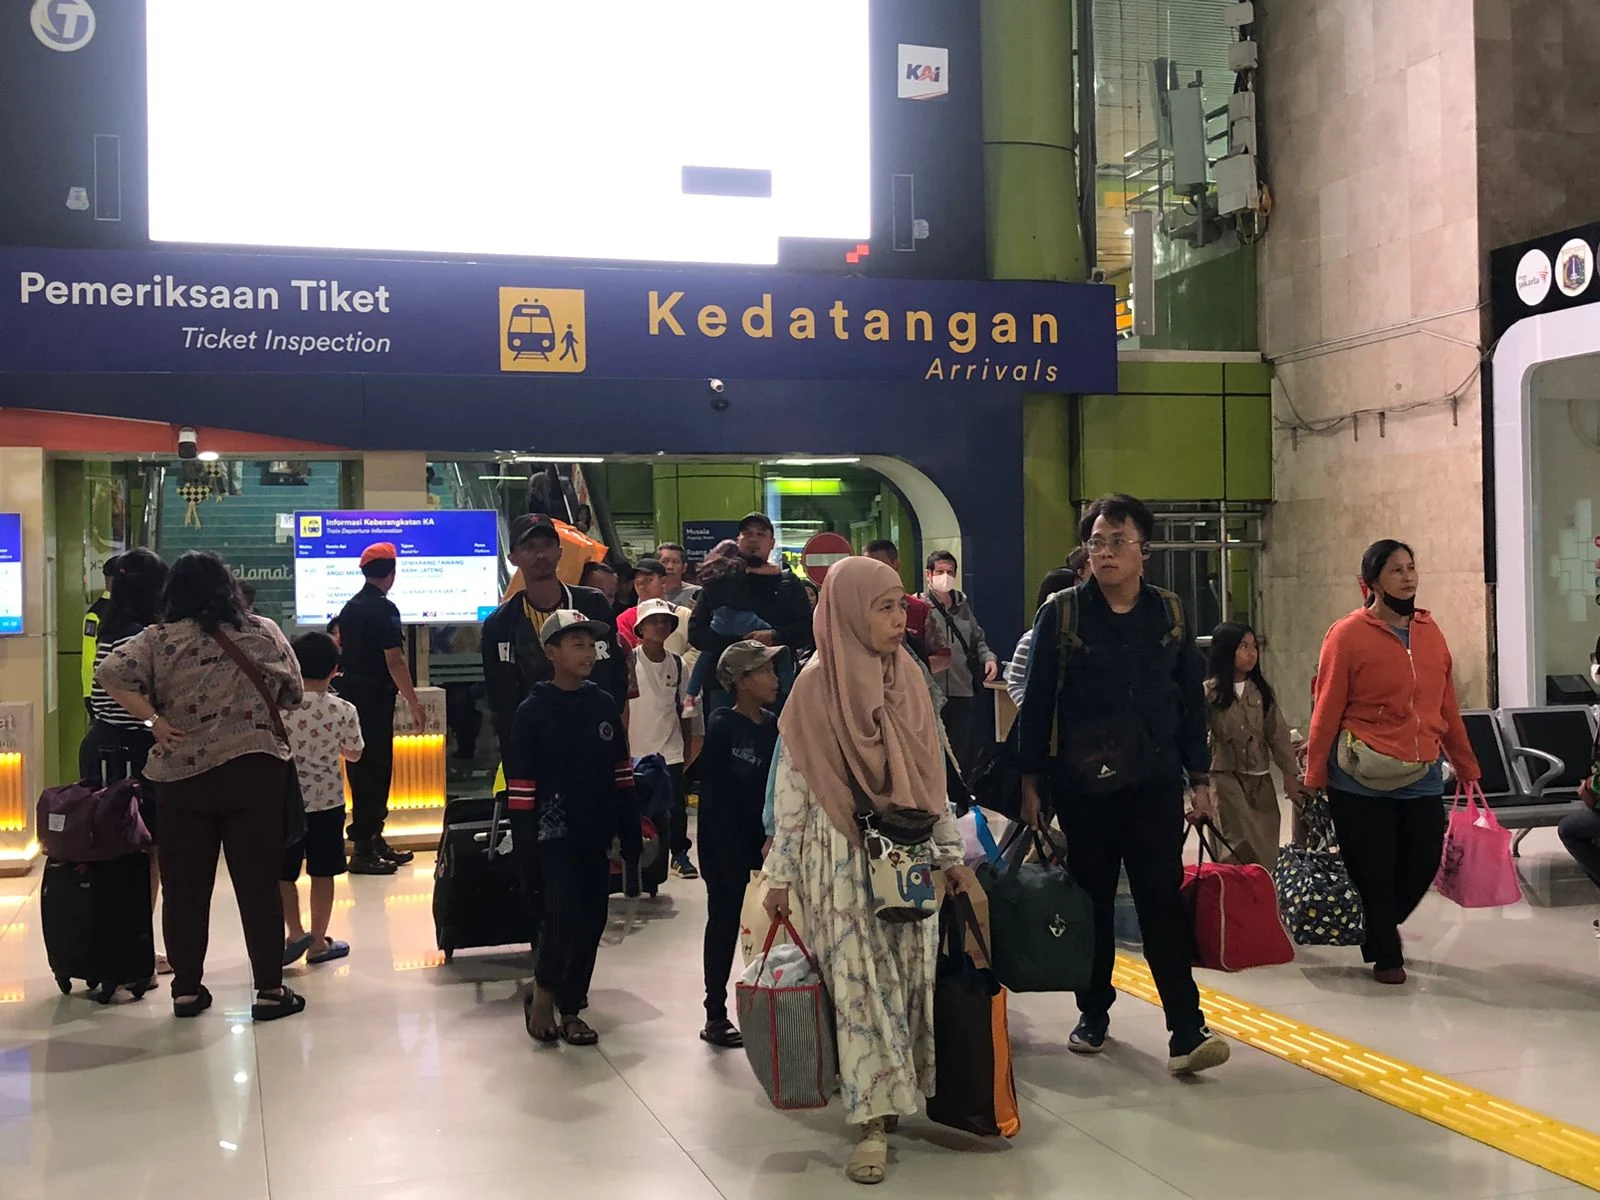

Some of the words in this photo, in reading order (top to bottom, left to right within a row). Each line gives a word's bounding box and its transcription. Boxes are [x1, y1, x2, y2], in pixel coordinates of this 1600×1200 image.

[20, 271, 279, 310] Pemeriksaan
[291, 279, 391, 314] Tiket
[648, 290, 1060, 354] Kedatangan
[182, 327, 257, 351] Ticket
[265, 329, 391, 356] Inspection
[926, 357, 1059, 383] Arrivals
[326, 518, 362, 526] Informasi
[364, 518, 421, 527] Keberangkatan
[423, 518, 436, 526] KA
[231, 564, 293, 581] elamat
